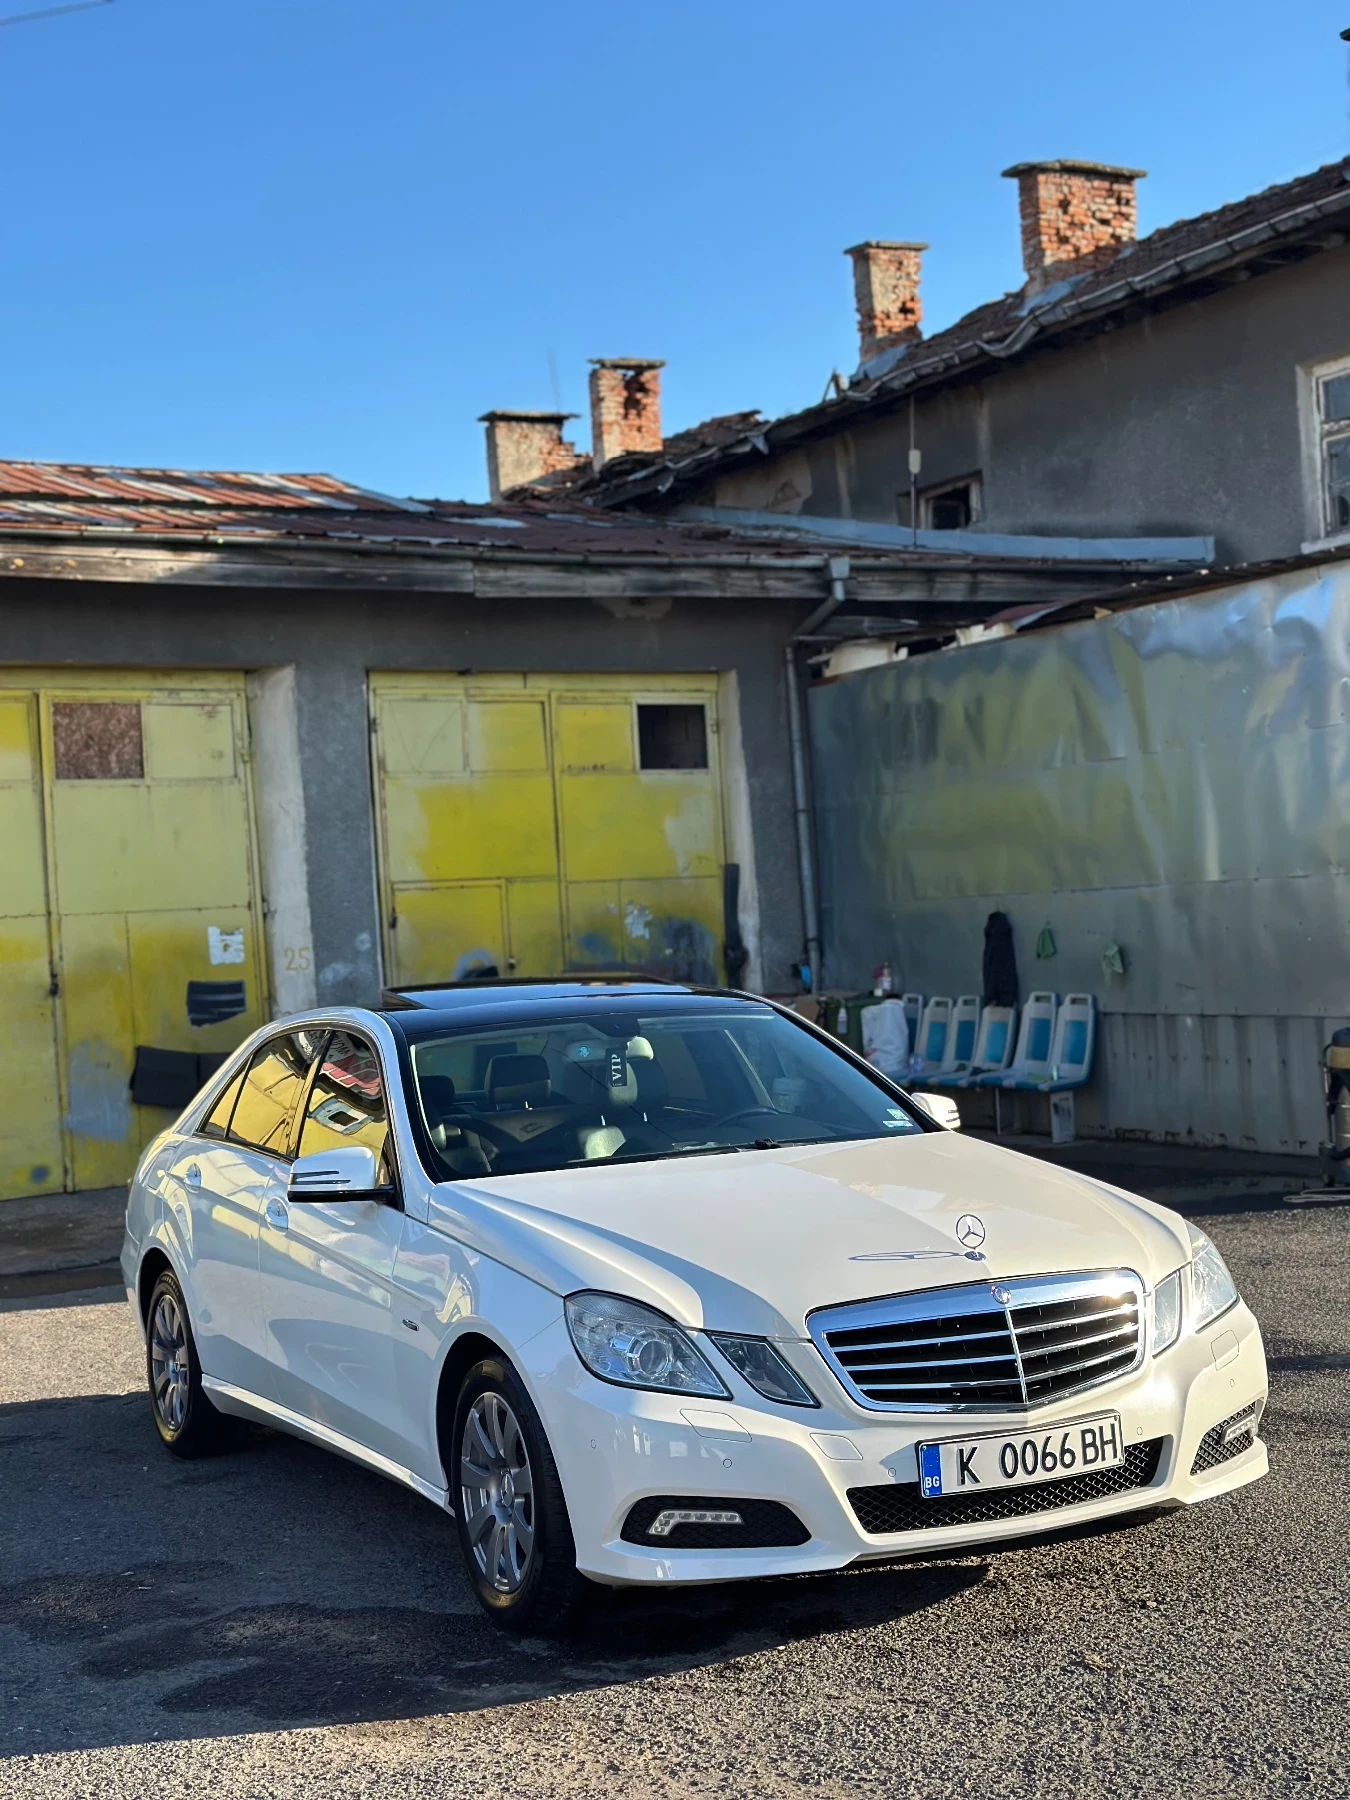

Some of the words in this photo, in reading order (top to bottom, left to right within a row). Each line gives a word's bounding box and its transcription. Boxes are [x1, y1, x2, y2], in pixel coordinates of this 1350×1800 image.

[284, 947, 311, 971] 25
[611, 1053, 622, 1081] VIP
[957, 1445, 983, 1486] K
[1000, 1432, 1076, 1479] 0066
[1080, 1423, 1118, 1465] BH
[925, 1476, 940, 1489] BG
